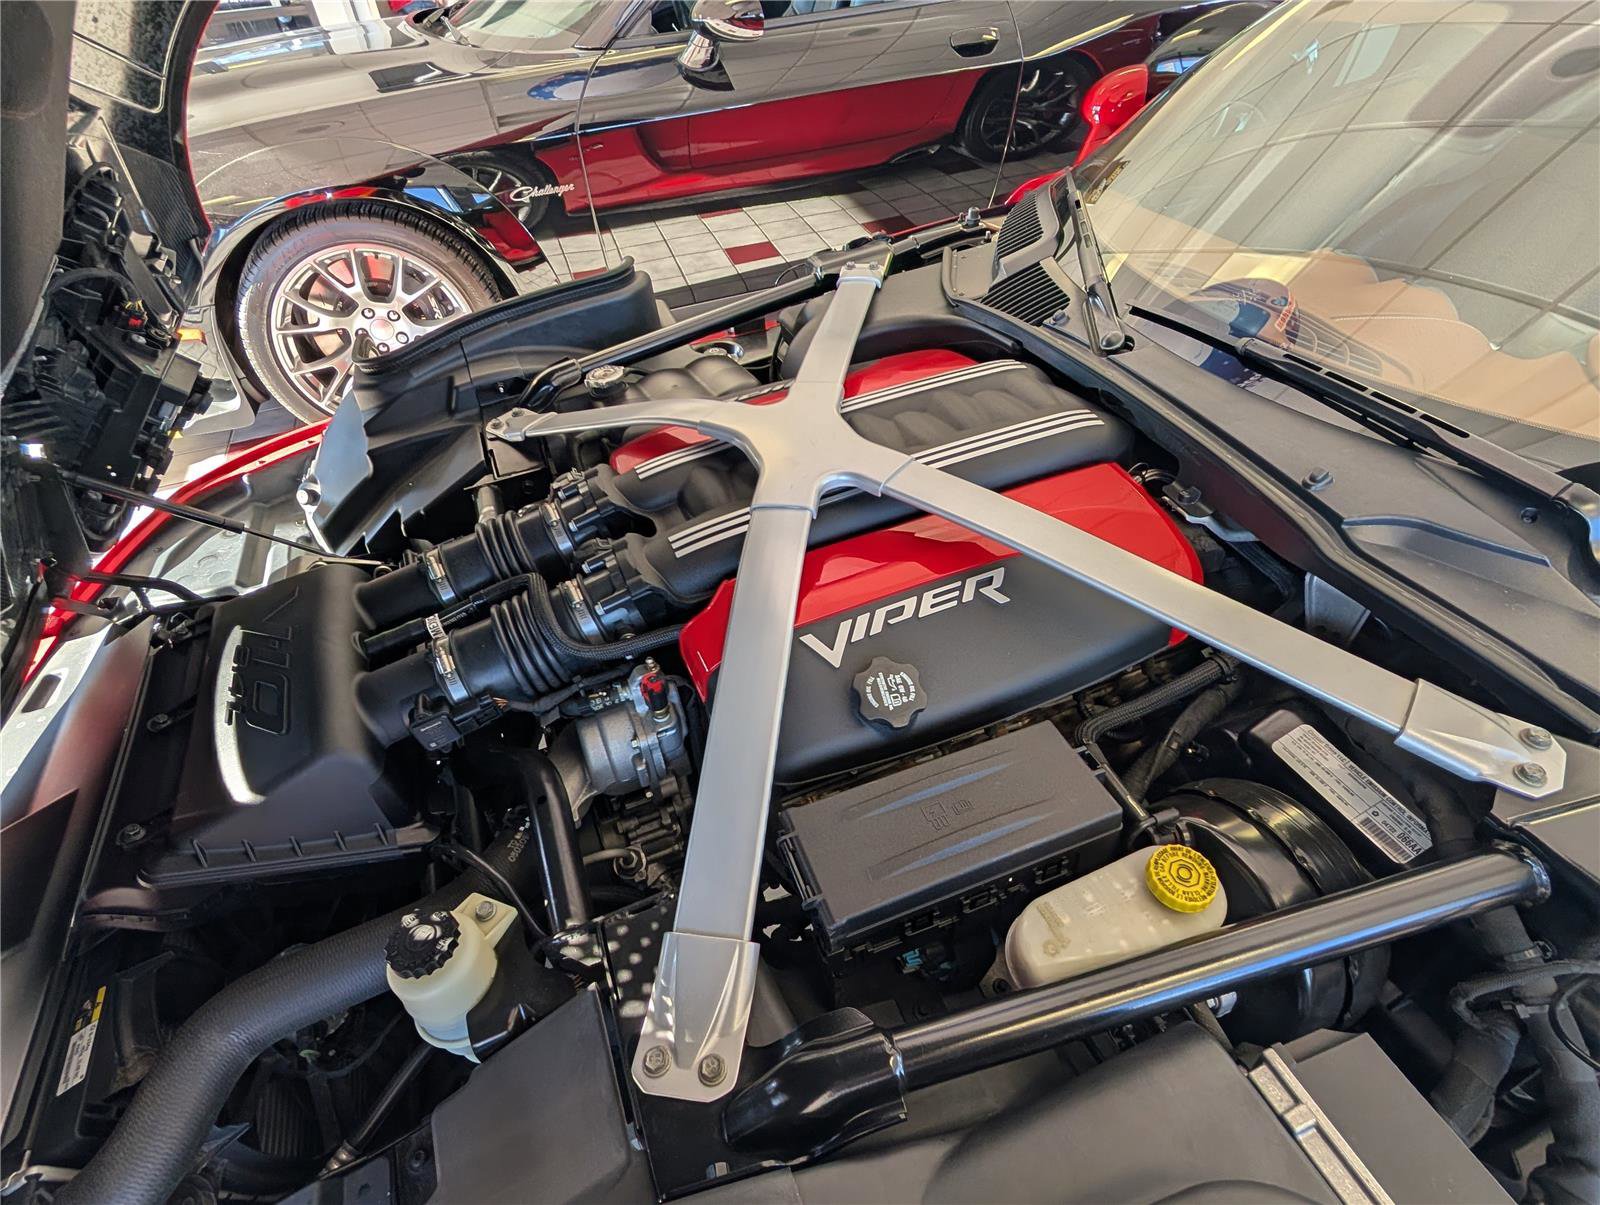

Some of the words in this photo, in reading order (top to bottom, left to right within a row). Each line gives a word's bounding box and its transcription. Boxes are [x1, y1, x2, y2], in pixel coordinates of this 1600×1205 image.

[510, 183, 575, 202] Challenger
[799, 567, 1011, 669] VIPER
[1385, 796, 1407, 815] CONTROL
[1396, 830, 1423, 855] 066AA
